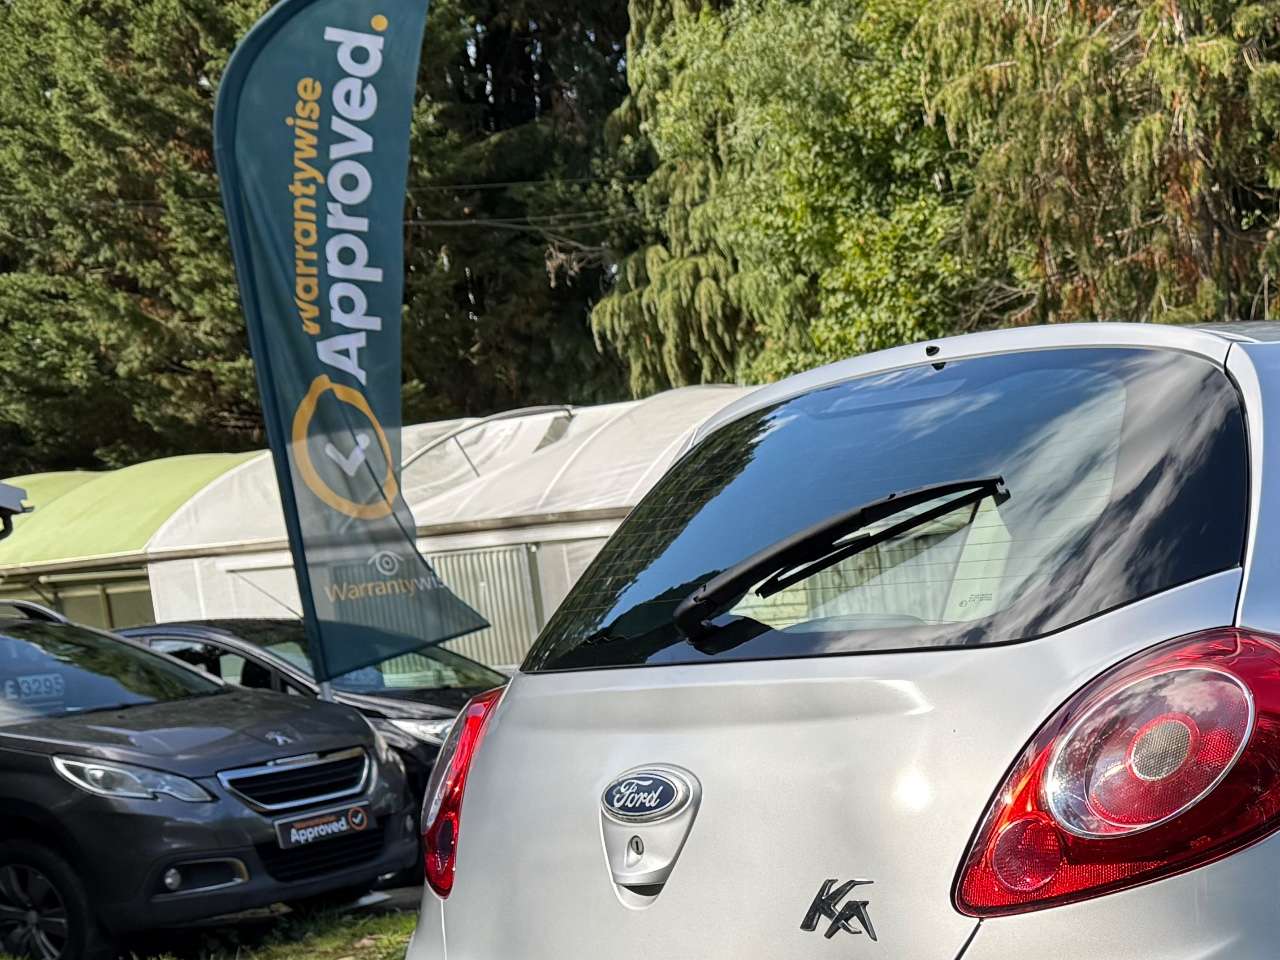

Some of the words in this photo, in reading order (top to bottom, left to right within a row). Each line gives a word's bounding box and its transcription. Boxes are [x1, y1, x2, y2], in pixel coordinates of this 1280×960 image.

[316, 14, 389, 387] Approved.
[612, 779, 664, 808] Ford
[799, 878, 878, 942] KA
